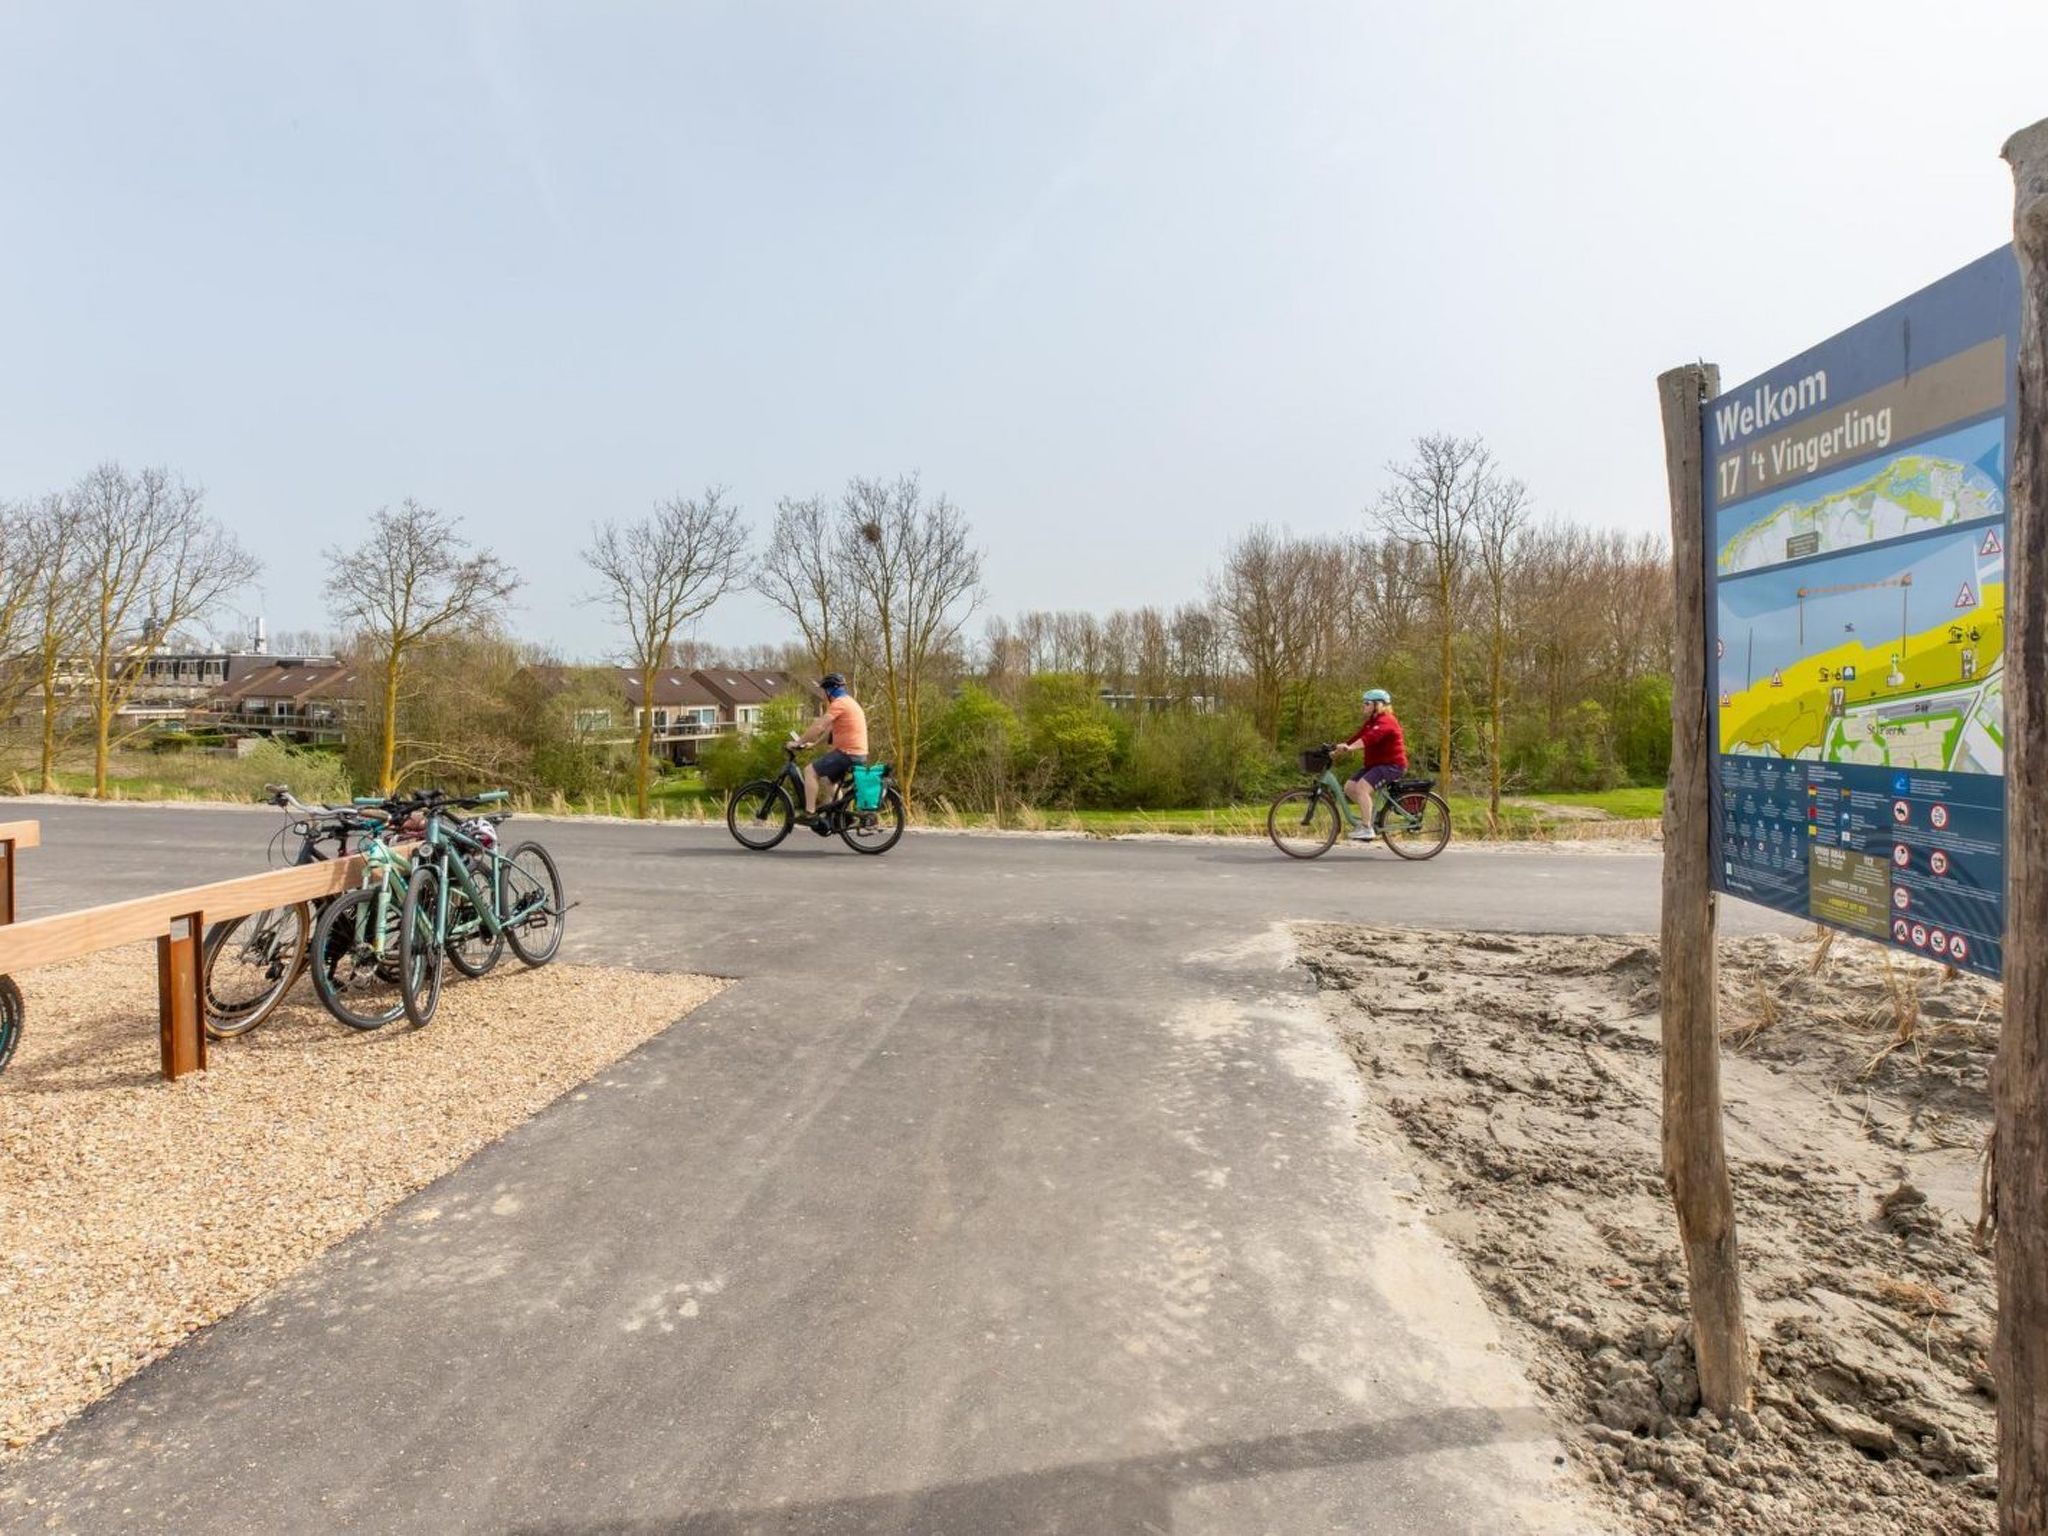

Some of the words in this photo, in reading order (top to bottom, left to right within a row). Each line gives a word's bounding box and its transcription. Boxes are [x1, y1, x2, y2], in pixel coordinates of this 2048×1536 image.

[1715, 369, 1827, 446] Welkom
[1719, 456, 1741, 498] 17
[1771, 407, 1892, 476] Vingerling
